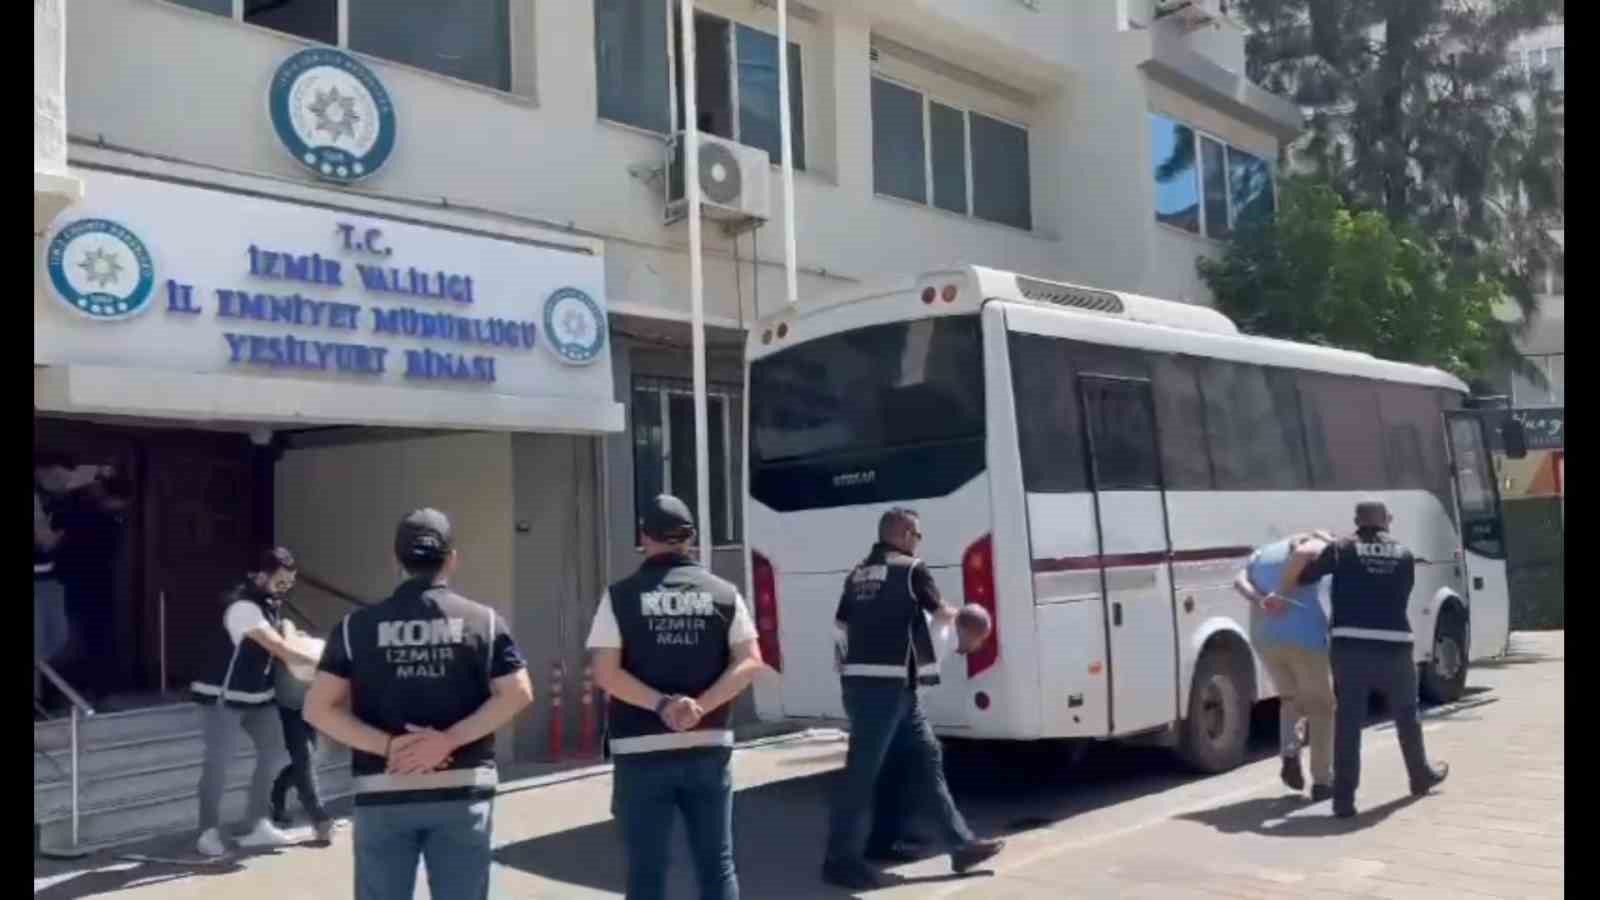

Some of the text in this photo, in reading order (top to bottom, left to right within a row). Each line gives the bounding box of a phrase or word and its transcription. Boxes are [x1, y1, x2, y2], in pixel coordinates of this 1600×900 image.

[338, 222, 392, 256] T.C.
[248, 244, 343, 287] İZMİR
[167, 279, 202, 314] İL
[215, 289, 361, 331] EMNİYET
[641, 591, 714, 616] KOM
[377, 618, 464, 647] KOM
